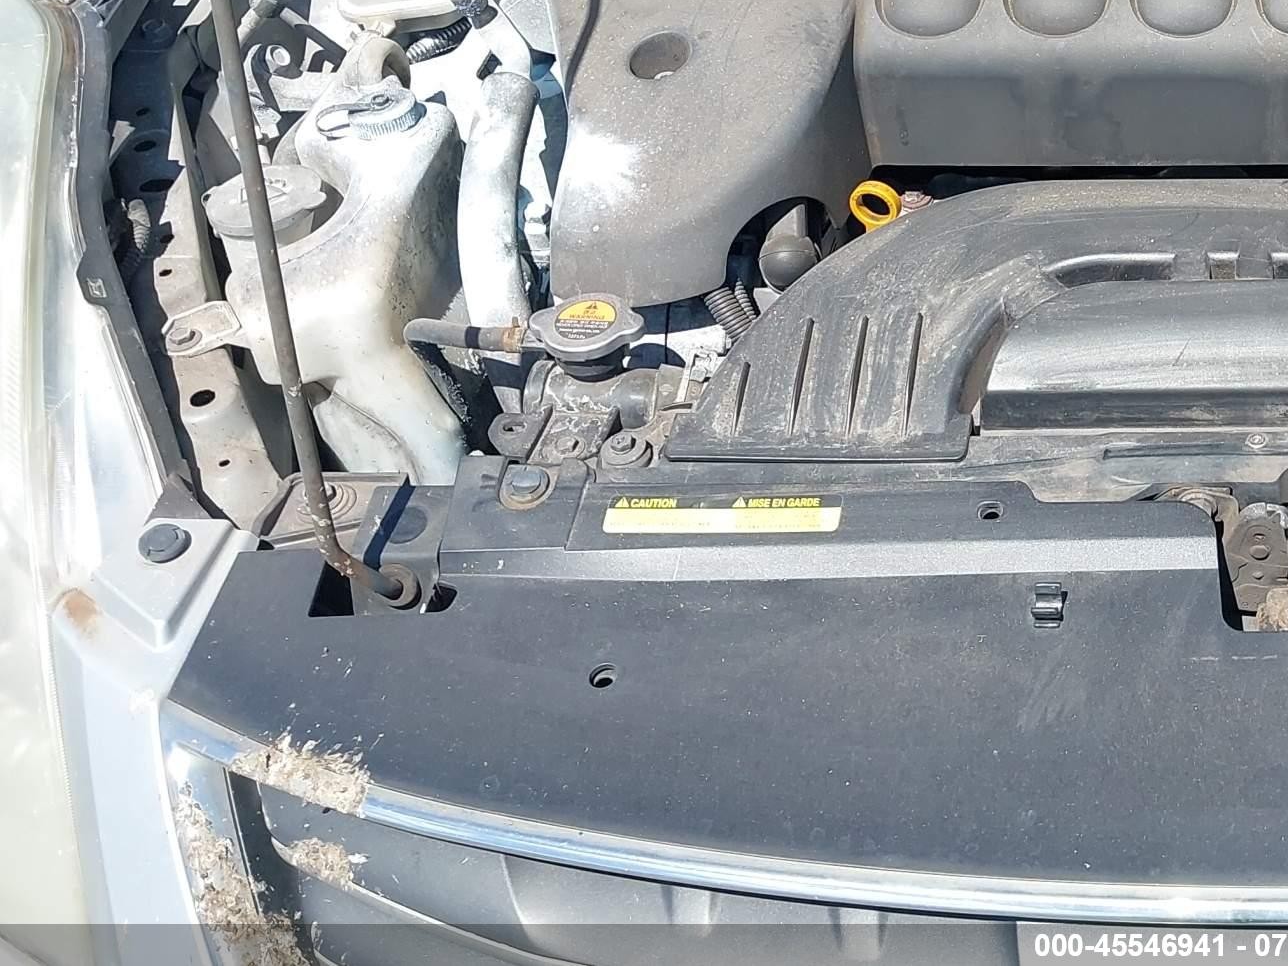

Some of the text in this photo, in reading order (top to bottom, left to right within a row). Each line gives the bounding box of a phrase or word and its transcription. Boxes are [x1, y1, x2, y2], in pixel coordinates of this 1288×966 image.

[630, 498, 678, 509] CAUTION
[747, 497, 822, 508] MISE EN GARDE
